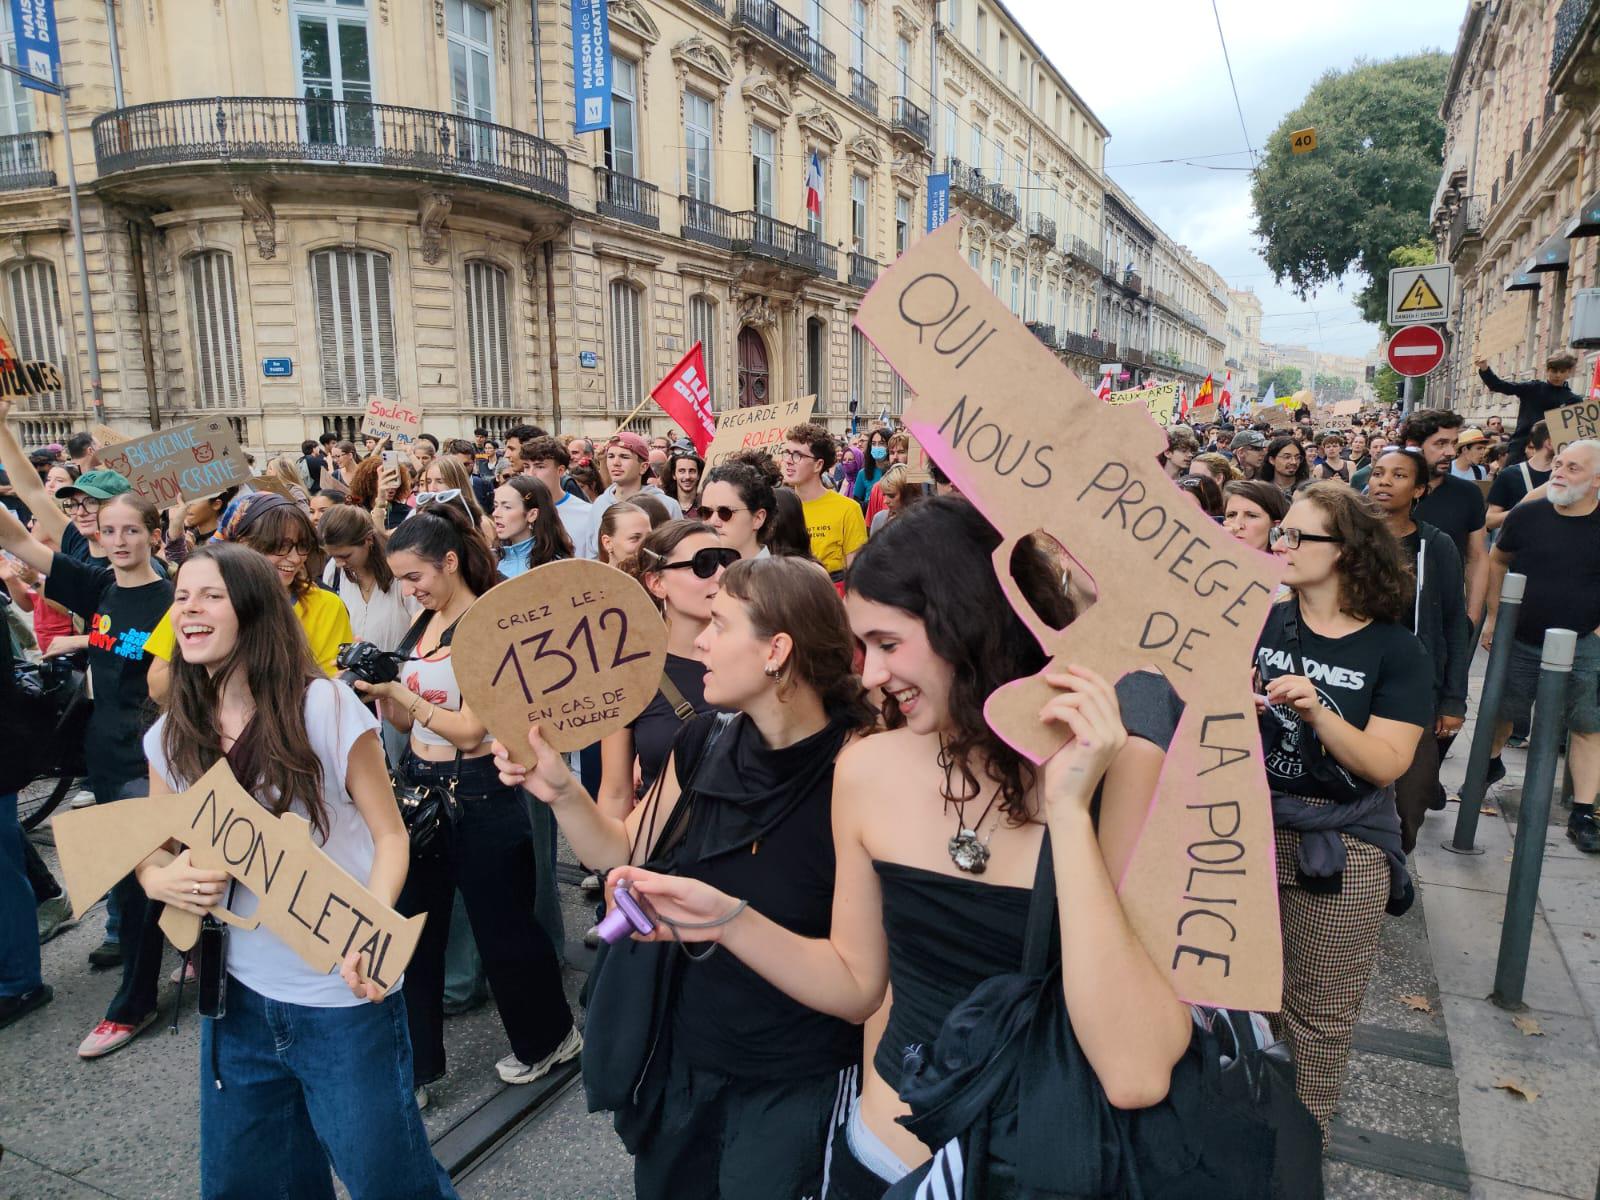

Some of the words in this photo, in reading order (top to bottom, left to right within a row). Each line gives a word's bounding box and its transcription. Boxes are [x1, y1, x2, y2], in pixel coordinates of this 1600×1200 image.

[581, 13, 591, 30] de
[581, 34, 592, 89] MAISON
[1295, 135, 1312, 147] 40
[899, 273, 998, 369] QUI
[721, 406, 779, 430] REGARDE
[784, 401, 799, 416] TA
[741, 425, 788, 449] ROLEX
[938, 395, 1054, 488] NOUS
[1561, 403, 1599, 429] PRO
[1577, 422, 1597, 438] EN
[1077, 462, 1270, 627] PROTEGE
[497, 605, 552, 630] CRIEZ
[1139, 611, 1210, 672] DE
[491, 607, 651, 704] 1312
[528, 708, 553, 722] EN
[561, 696, 596, 714] CAS
[602, 688, 626, 705] DE
[554, 707, 620, 731] VIOLENCE
[1196, 713, 1251, 776] LA
[191, 789, 285, 894] NON
[1171, 801, 1247, 978] POLICE
[287, 870, 392, 989] LETAL
